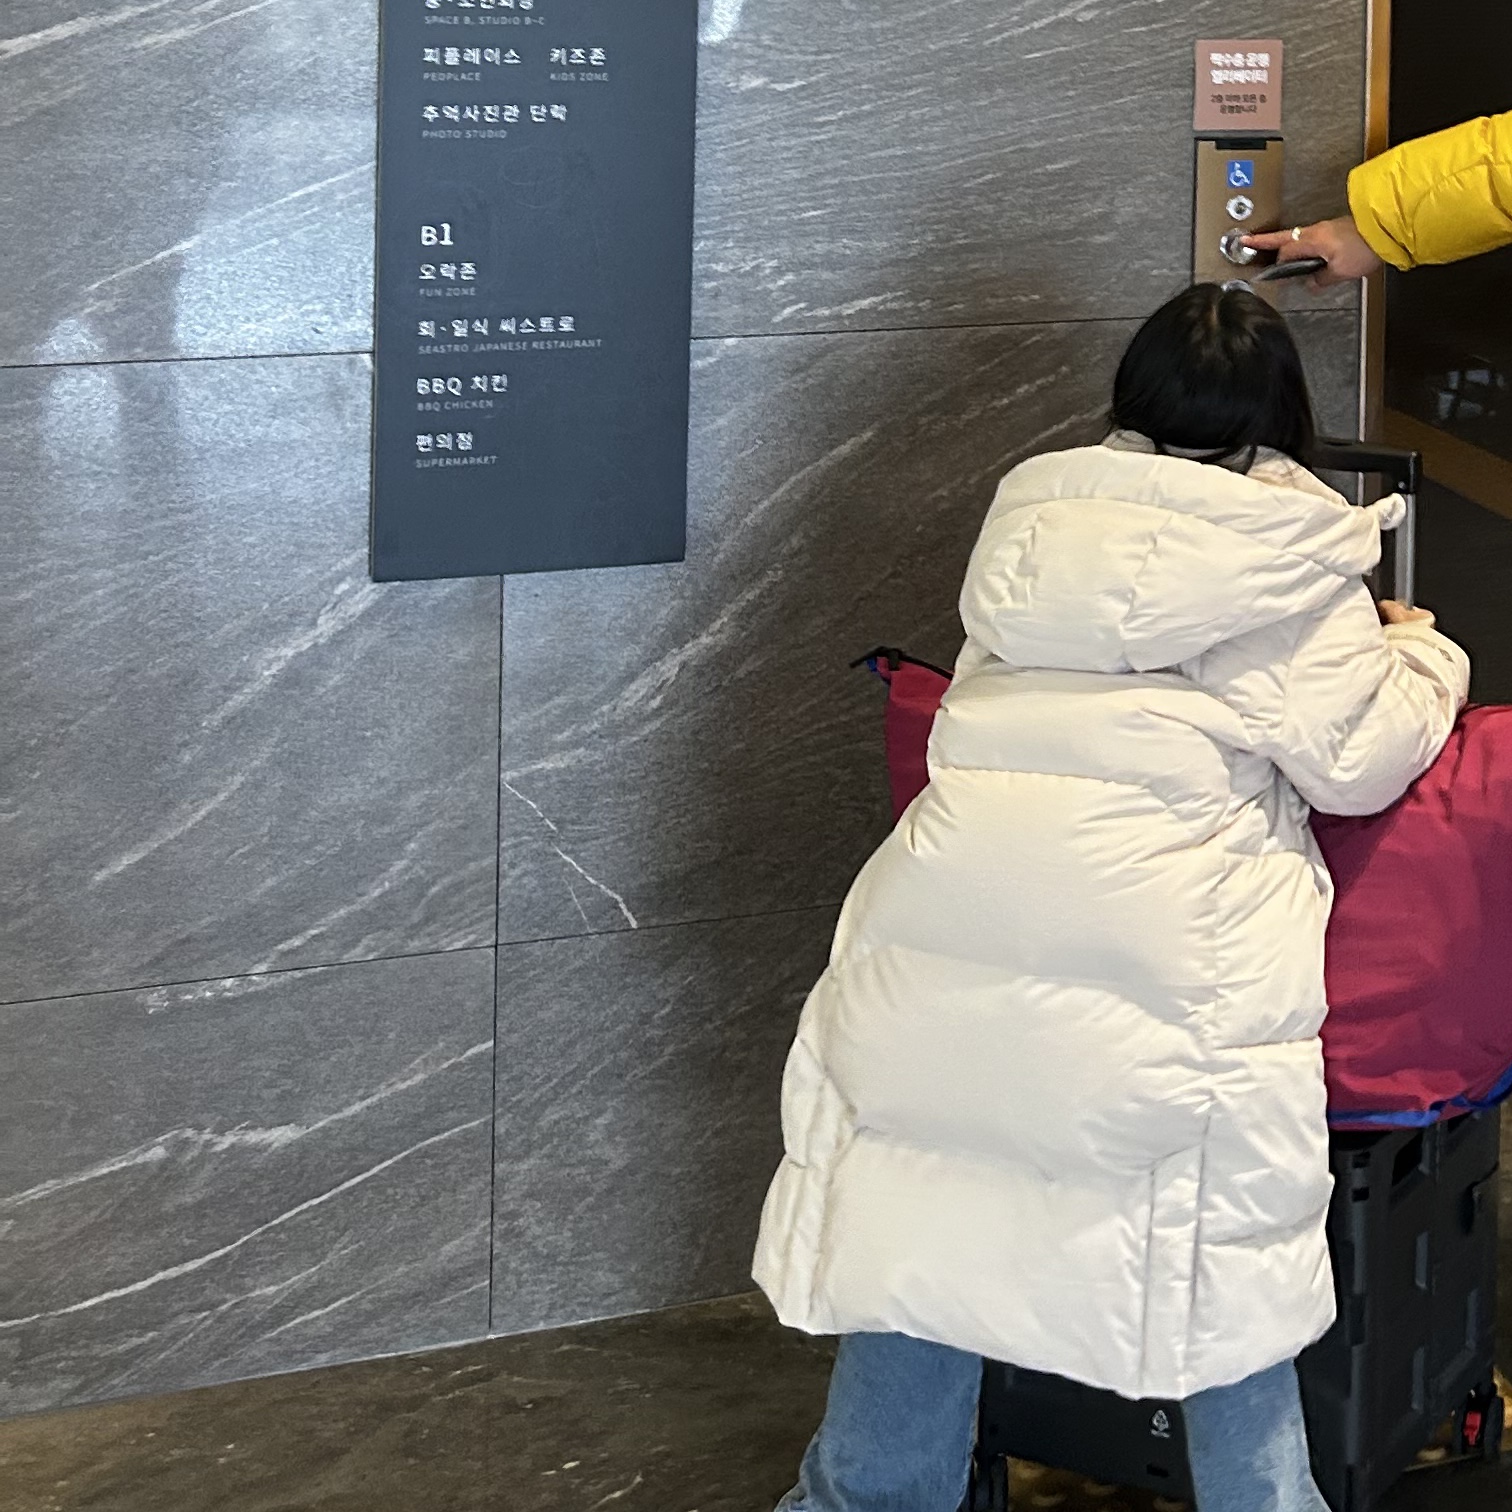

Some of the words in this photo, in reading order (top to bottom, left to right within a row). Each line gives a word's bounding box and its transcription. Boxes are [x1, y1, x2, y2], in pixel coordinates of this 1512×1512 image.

[423, 47, 521, 66] 피플레이스
[550, 47, 608, 66] 키즈존
[422, 104, 520, 123] 추억사진관
[420, 223, 454, 246] B1
[418, 262, 477, 281] 오락존
[416, 377, 463, 396] BBQ
[470, 374, 509, 392] 치킨
[416, 432, 473, 452] 편의점
[416, 454, 498, 469] SUPERMARKET
